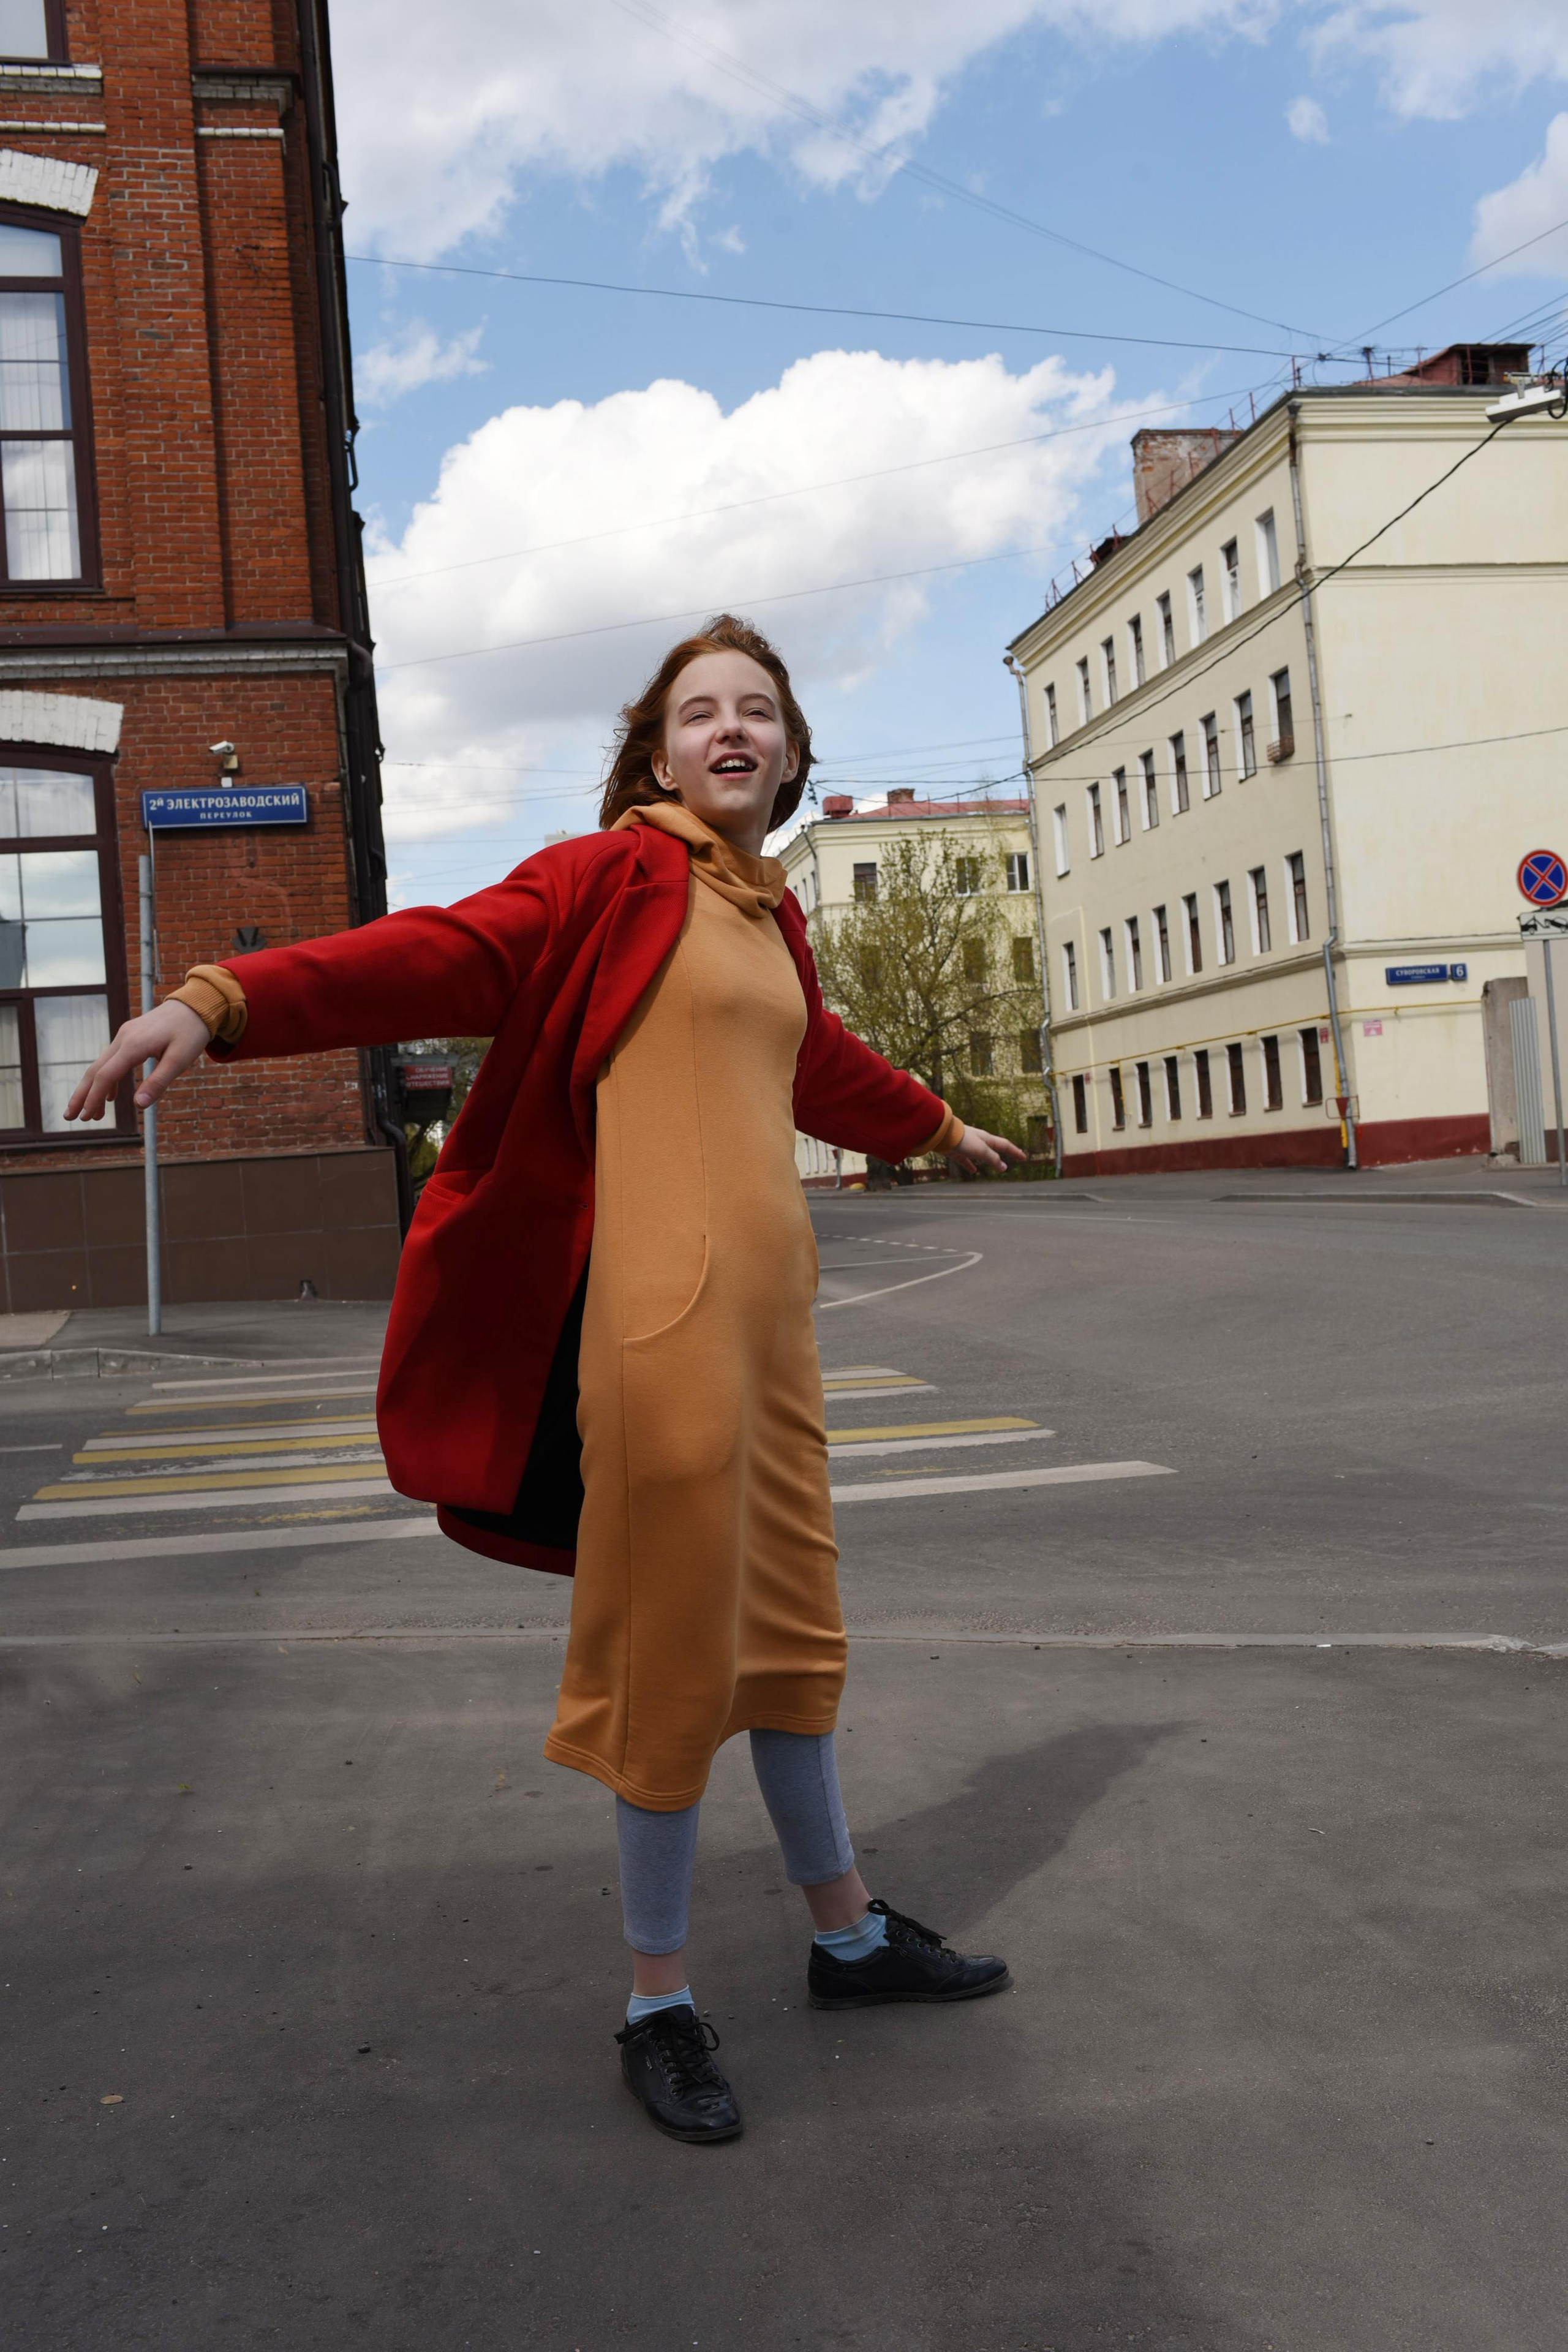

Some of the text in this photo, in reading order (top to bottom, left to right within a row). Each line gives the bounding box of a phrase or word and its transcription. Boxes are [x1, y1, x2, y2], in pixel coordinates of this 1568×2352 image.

[167, 793, 300, 810] ЭЛЕКТРОЗАВОДСКИЙ
[200, 811, 252, 820] ПЕРЕУЛОК
[1455, 965, 1464, 977] 6
